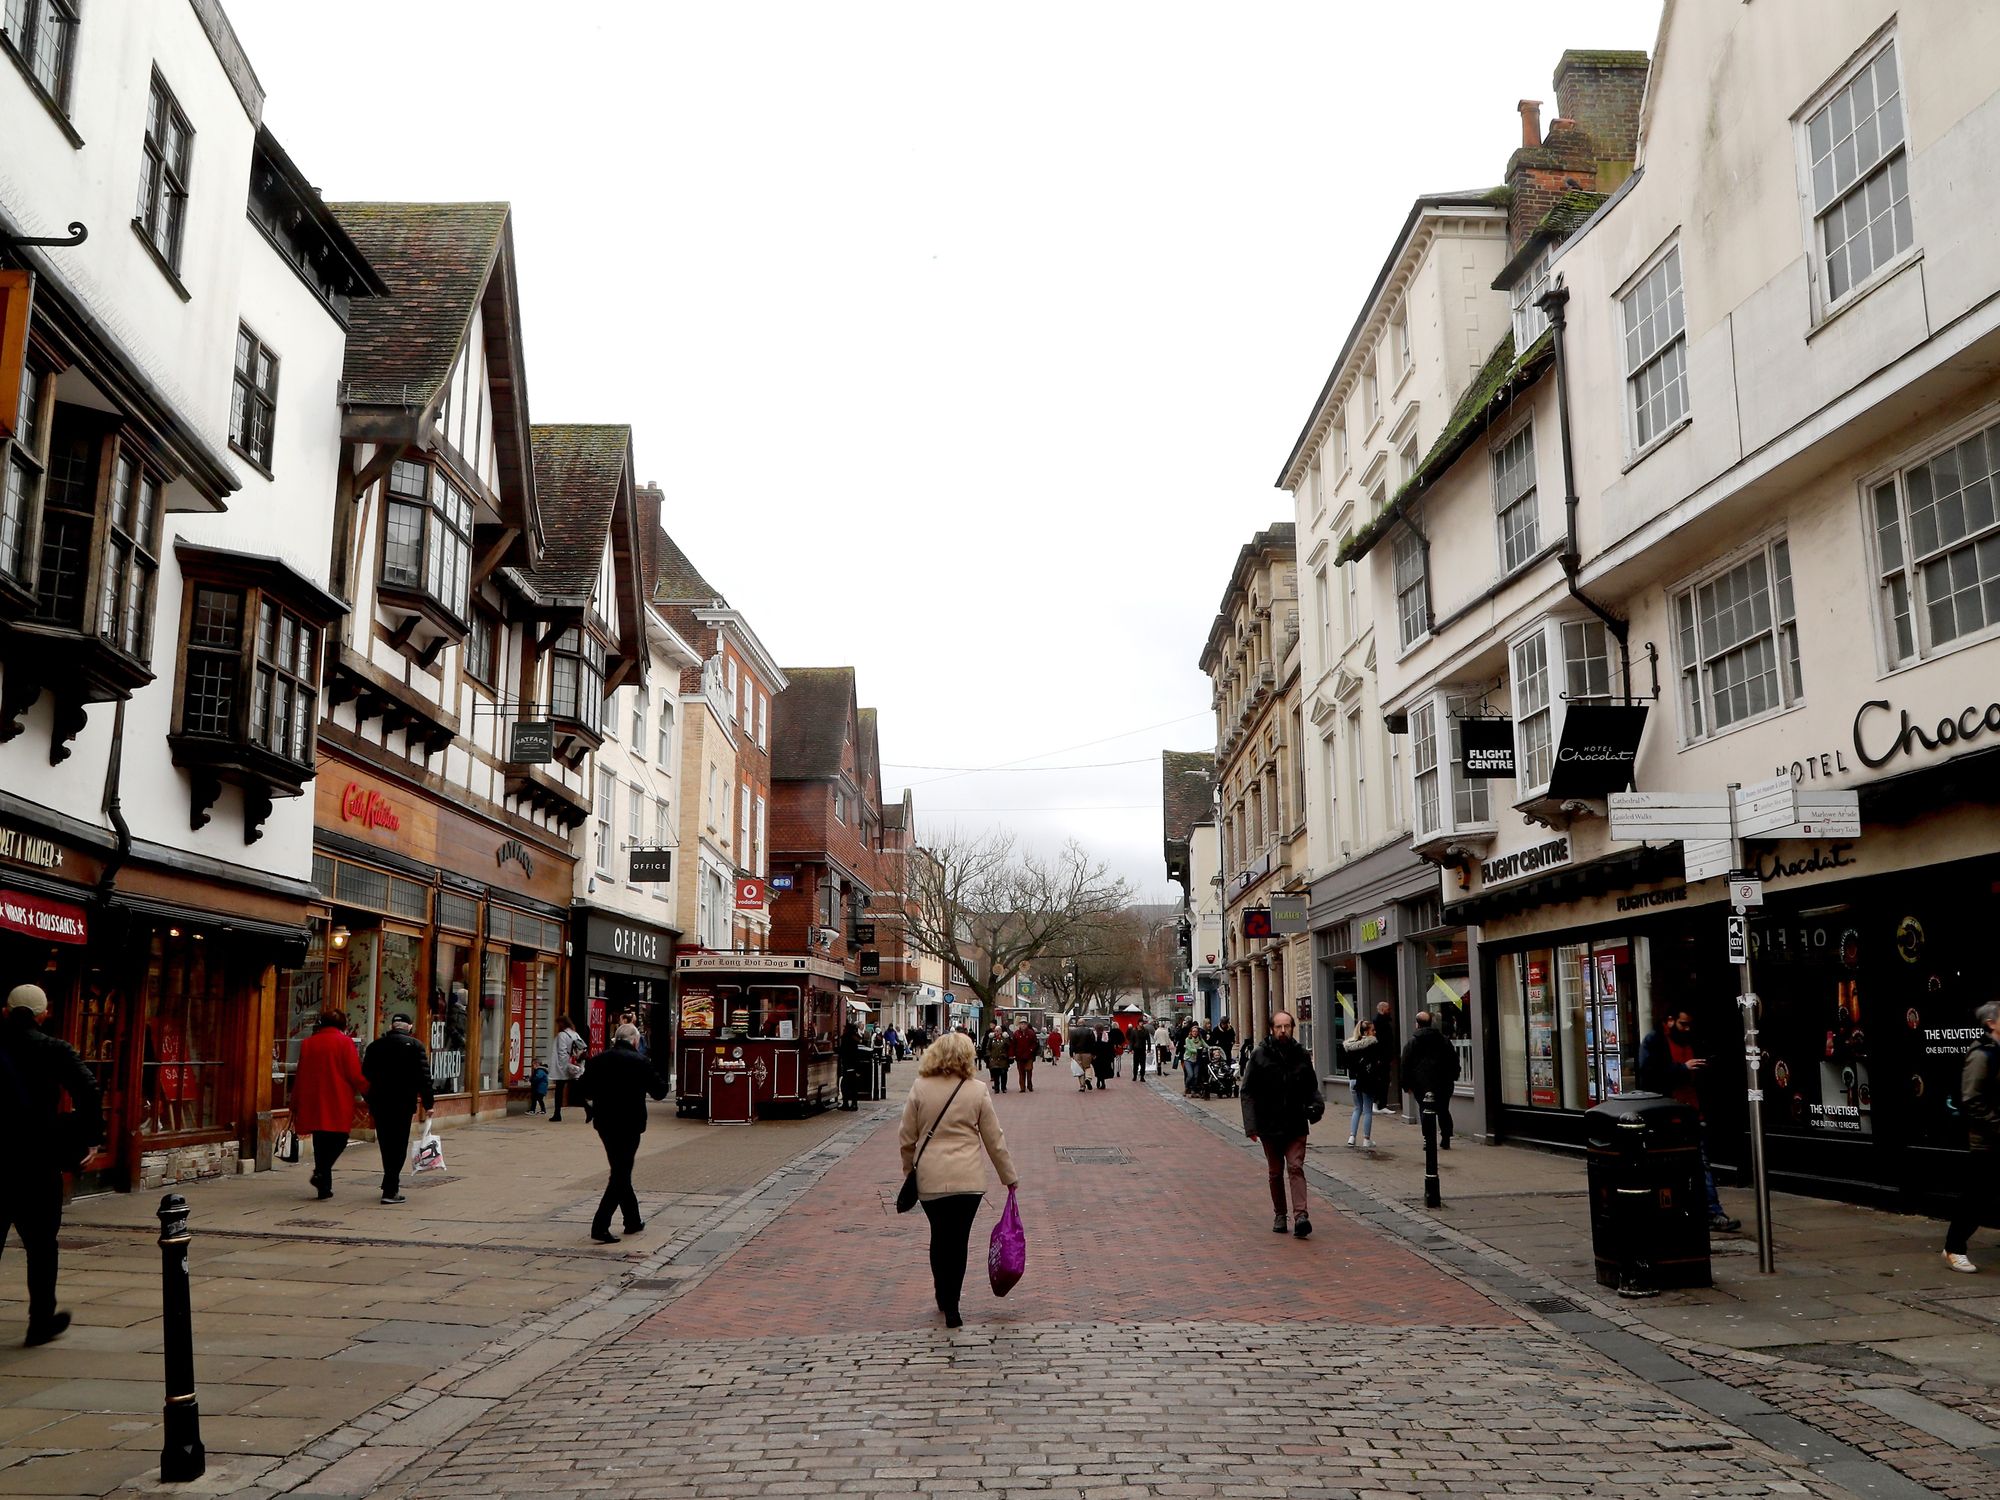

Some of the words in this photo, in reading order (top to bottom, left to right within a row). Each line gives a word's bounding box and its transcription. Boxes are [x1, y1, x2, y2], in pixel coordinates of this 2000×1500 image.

[1469, 750, 1512, 759] FLIGHT
[1467, 760, 1514, 770] CENTRE
[0, 826, 16, 857] RET
[25, 836, 55, 868] MANGER
[1482, 852, 1520, 884] FLIGHT
[1519, 837, 1569, 872] CENTRE
[5, 902, 27, 925] WRAPS
[35, 911, 77, 935] CROISSANTS
[614, 927, 657, 960] OFFICE
[1730, 938, 1742, 946] CCTV
[696, 958, 715, 967] Foot
[718, 958, 741, 967] Long
[764, 959, 789, 967] Dogs
[1530, 990, 1541, 999] SALE
[431, 1021, 446, 1049] GET
[1924, 1029, 1940, 1040] THE
[1926, 1046, 1937, 1054] ONE
[430, 1050, 461, 1080] LAYERED
[165, 1069, 188, 1080] SAE
[1810, 1104, 1822, 1114] THE
[1822, 1104, 1859, 1116] VELVETISER
